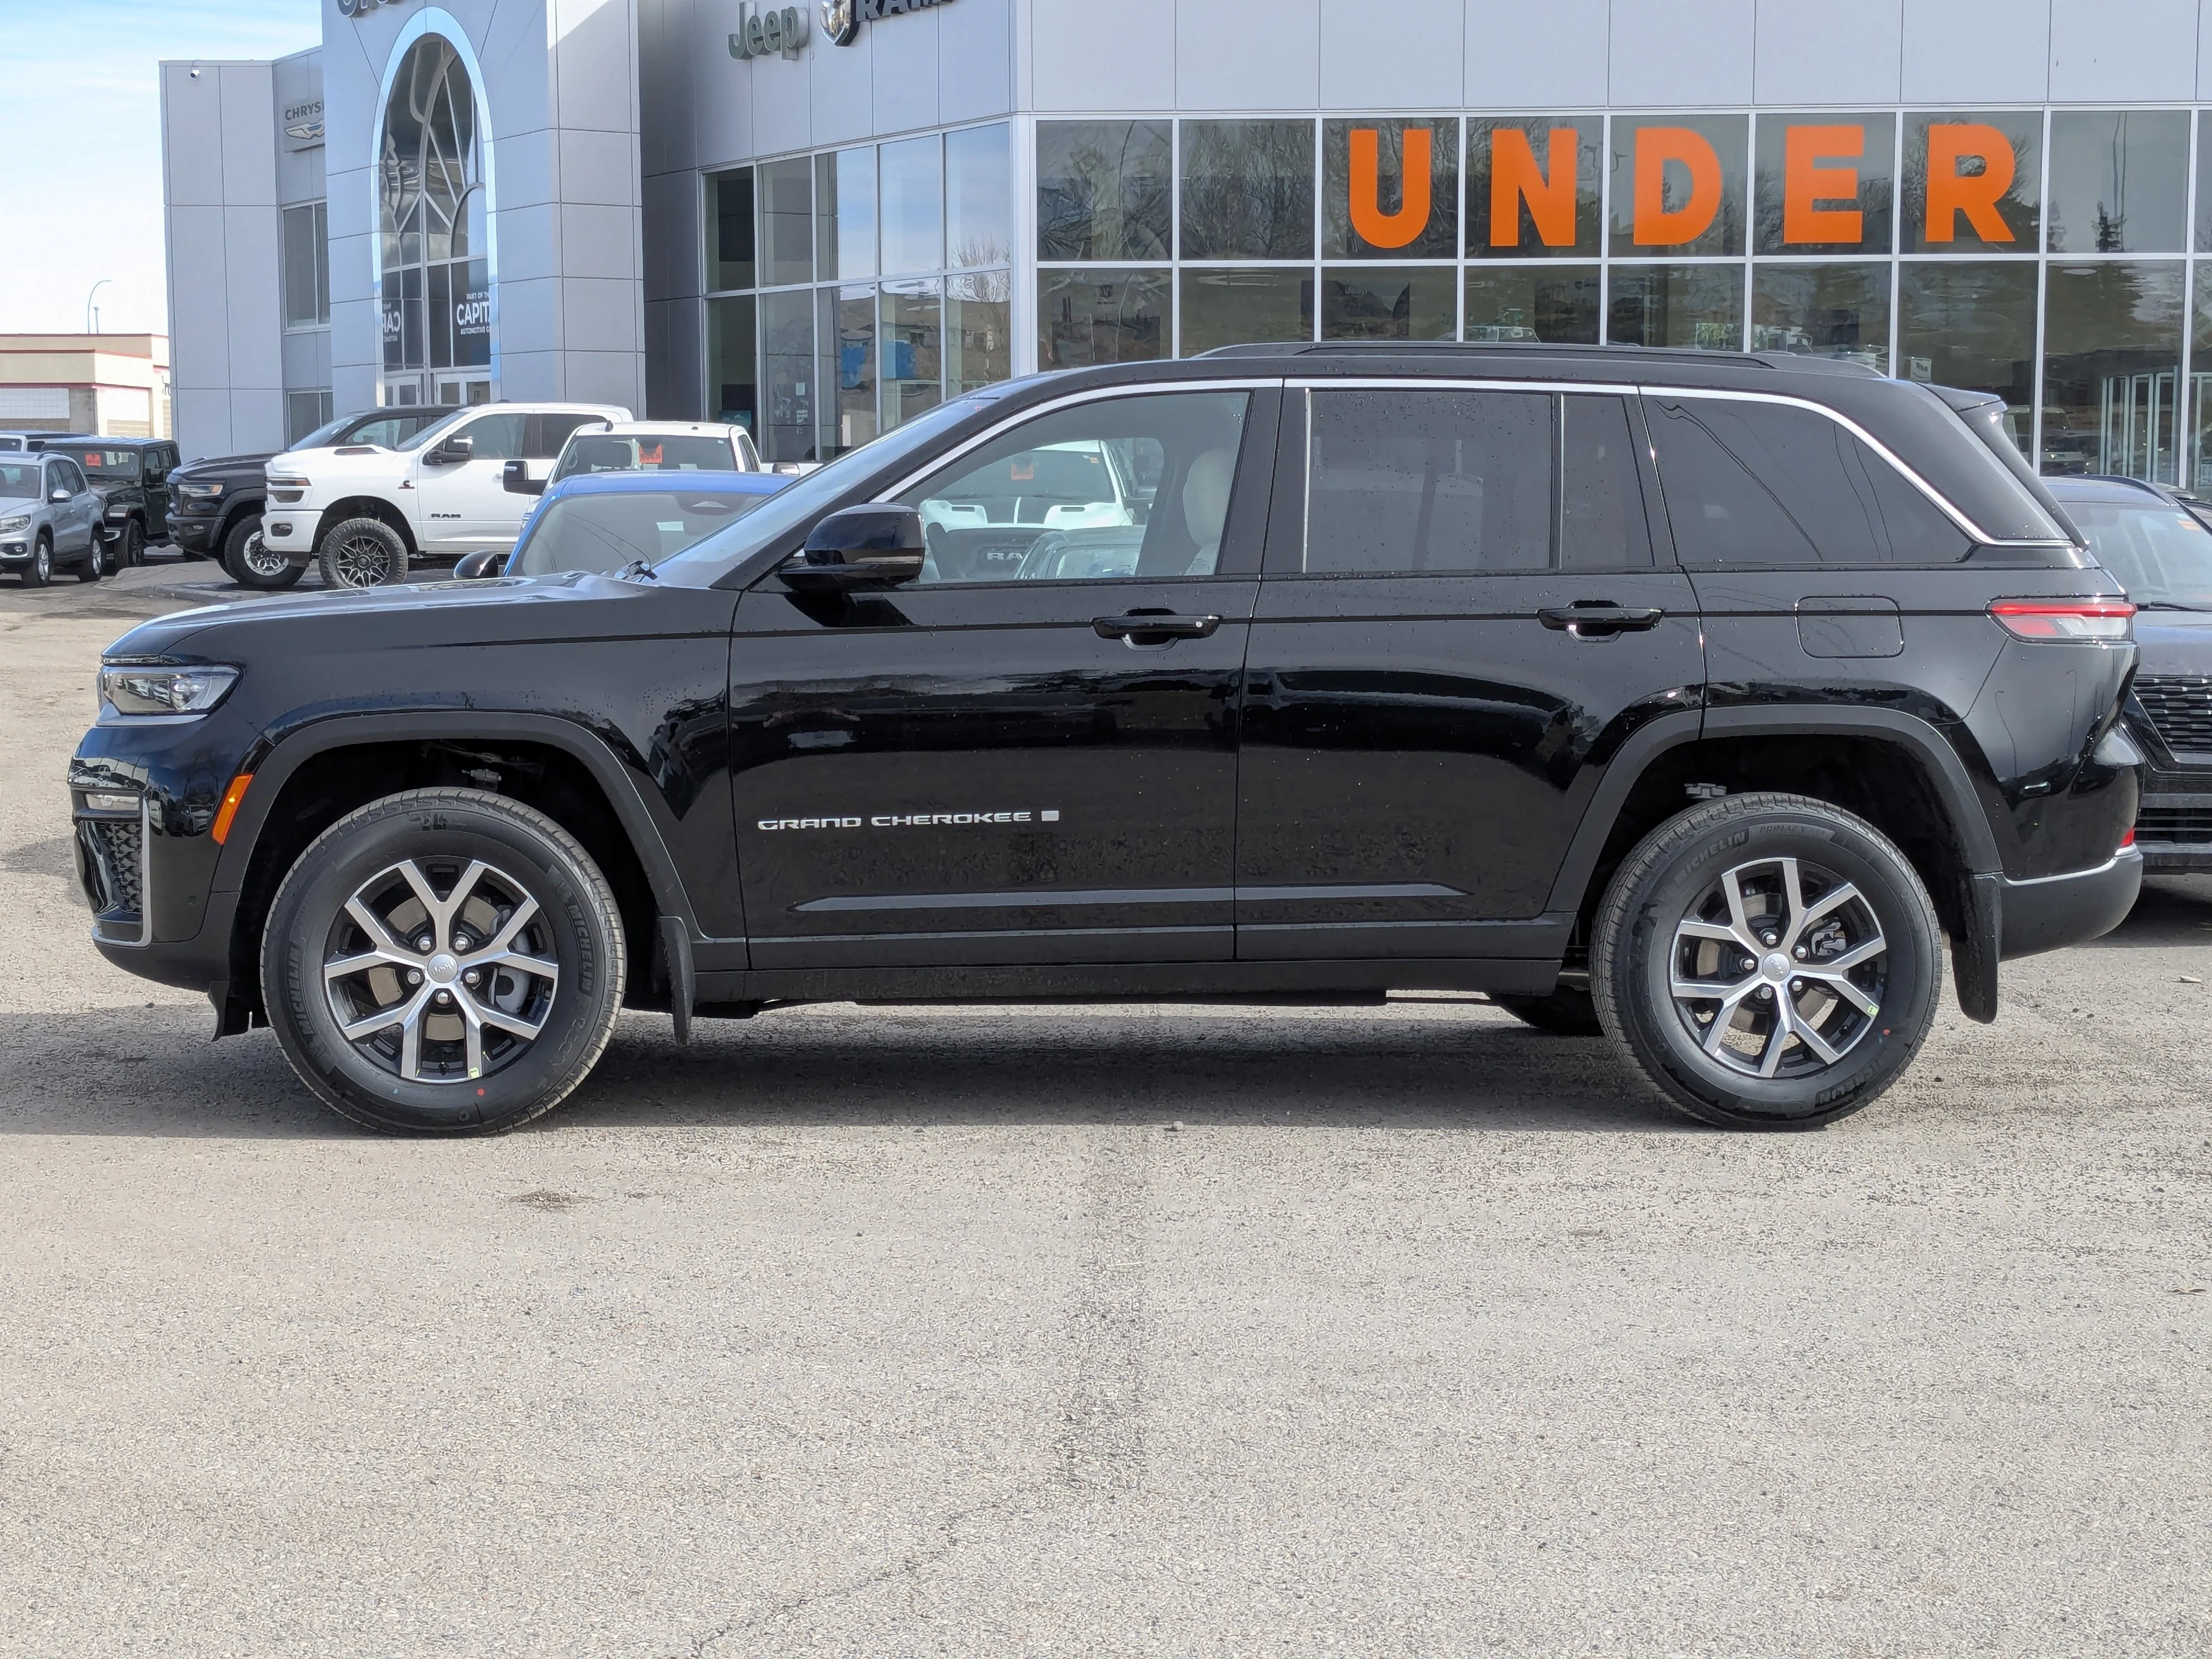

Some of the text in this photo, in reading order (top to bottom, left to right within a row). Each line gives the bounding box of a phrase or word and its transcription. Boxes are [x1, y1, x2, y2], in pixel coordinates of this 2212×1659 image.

[728, 2, 799, 60] Jeep
[285, 100, 324, 120] CHRYS
[1348, 123, 2017, 249] UNDER
[457, 301, 489, 325] CAPIT
[758, 812, 1032, 830] GRAND CHEROKEE
[568, 904, 593, 991] MICHELIN
[288, 945, 314, 1035] MICHELIN
